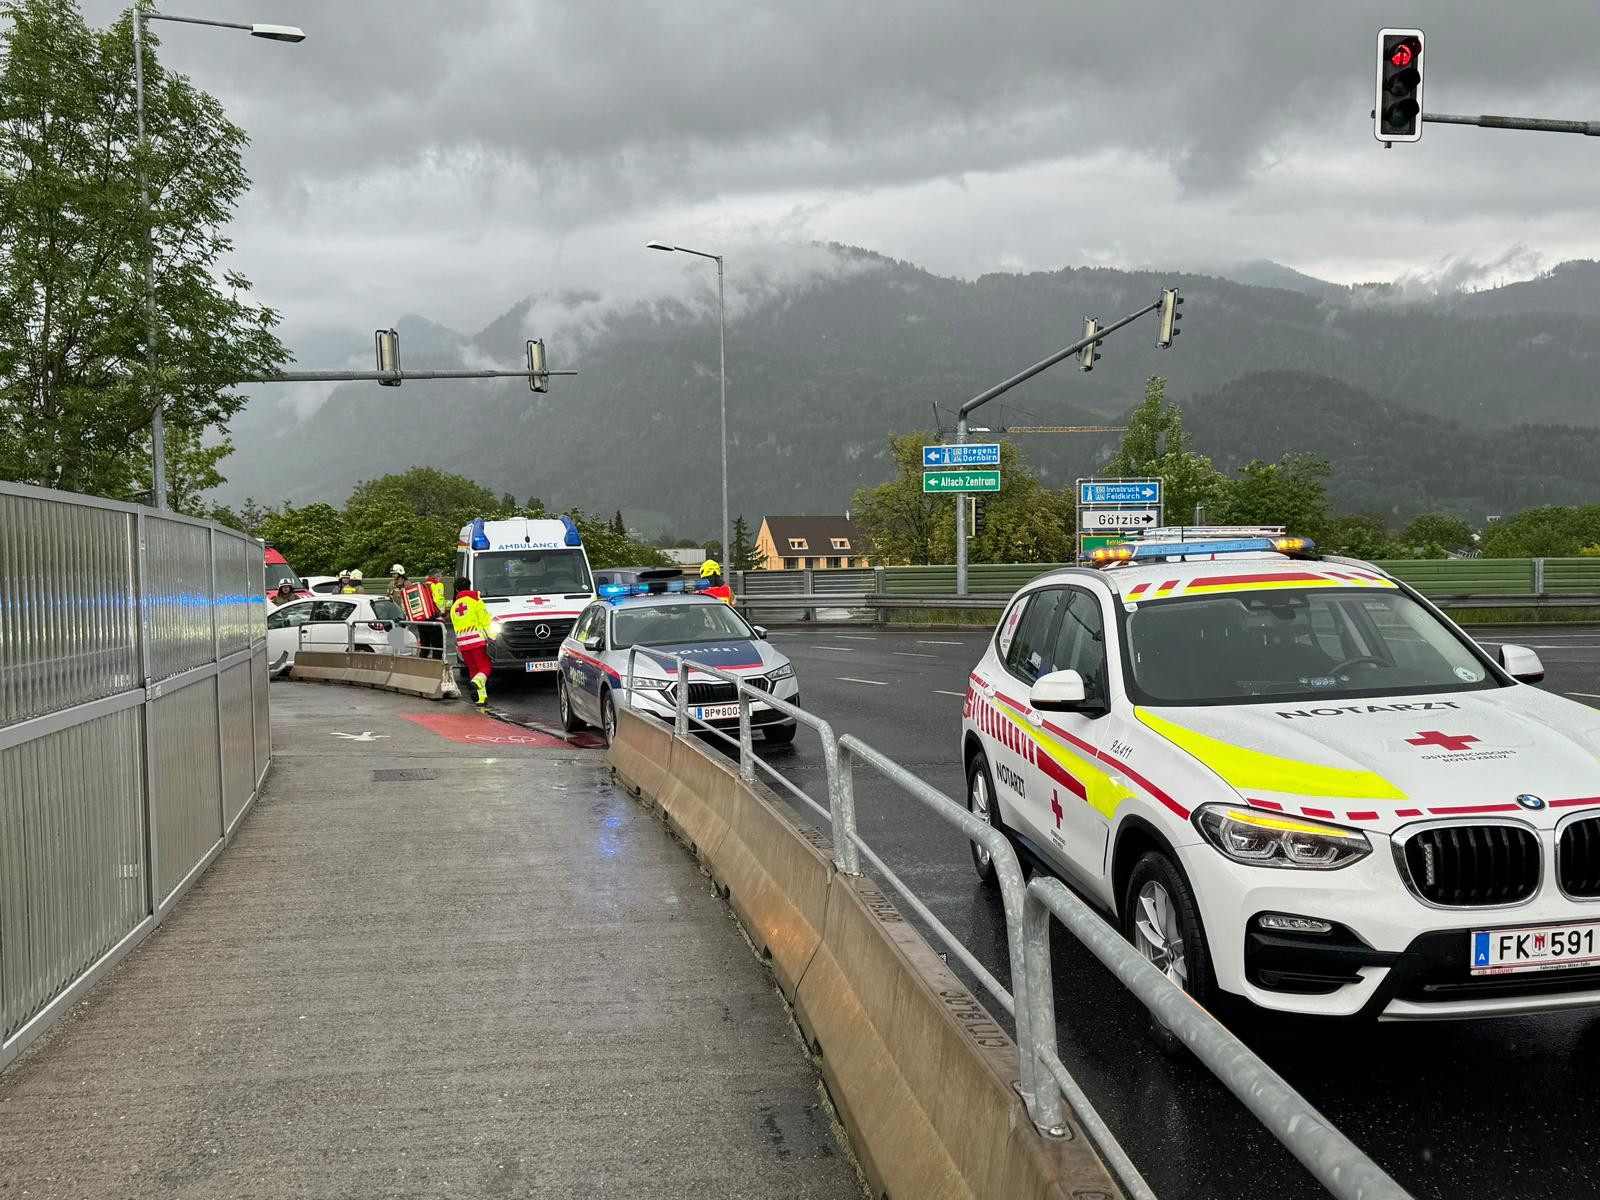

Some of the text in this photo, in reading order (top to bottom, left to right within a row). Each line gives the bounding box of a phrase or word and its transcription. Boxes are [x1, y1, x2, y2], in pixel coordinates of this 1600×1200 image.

[963, 447, 997, 455] Bregenz
[963, 454, 997, 462] Dornbirn
[941, 476, 996, 487] Altach Zentrum
[1106, 485, 1140, 493] Innsbruck
[1106, 492, 1140, 500] Feldkirch
[1098, 514, 1140, 525] Götzis
[704, 706, 740, 718] BP 800
[1276, 702, 1460, 719] NOTARZT
[996, 761, 1026, 799] NOTARZT
[1478, 929, 1593, 961] A FK 591
[939, 991, 1010, 1048] CITYBLOC
